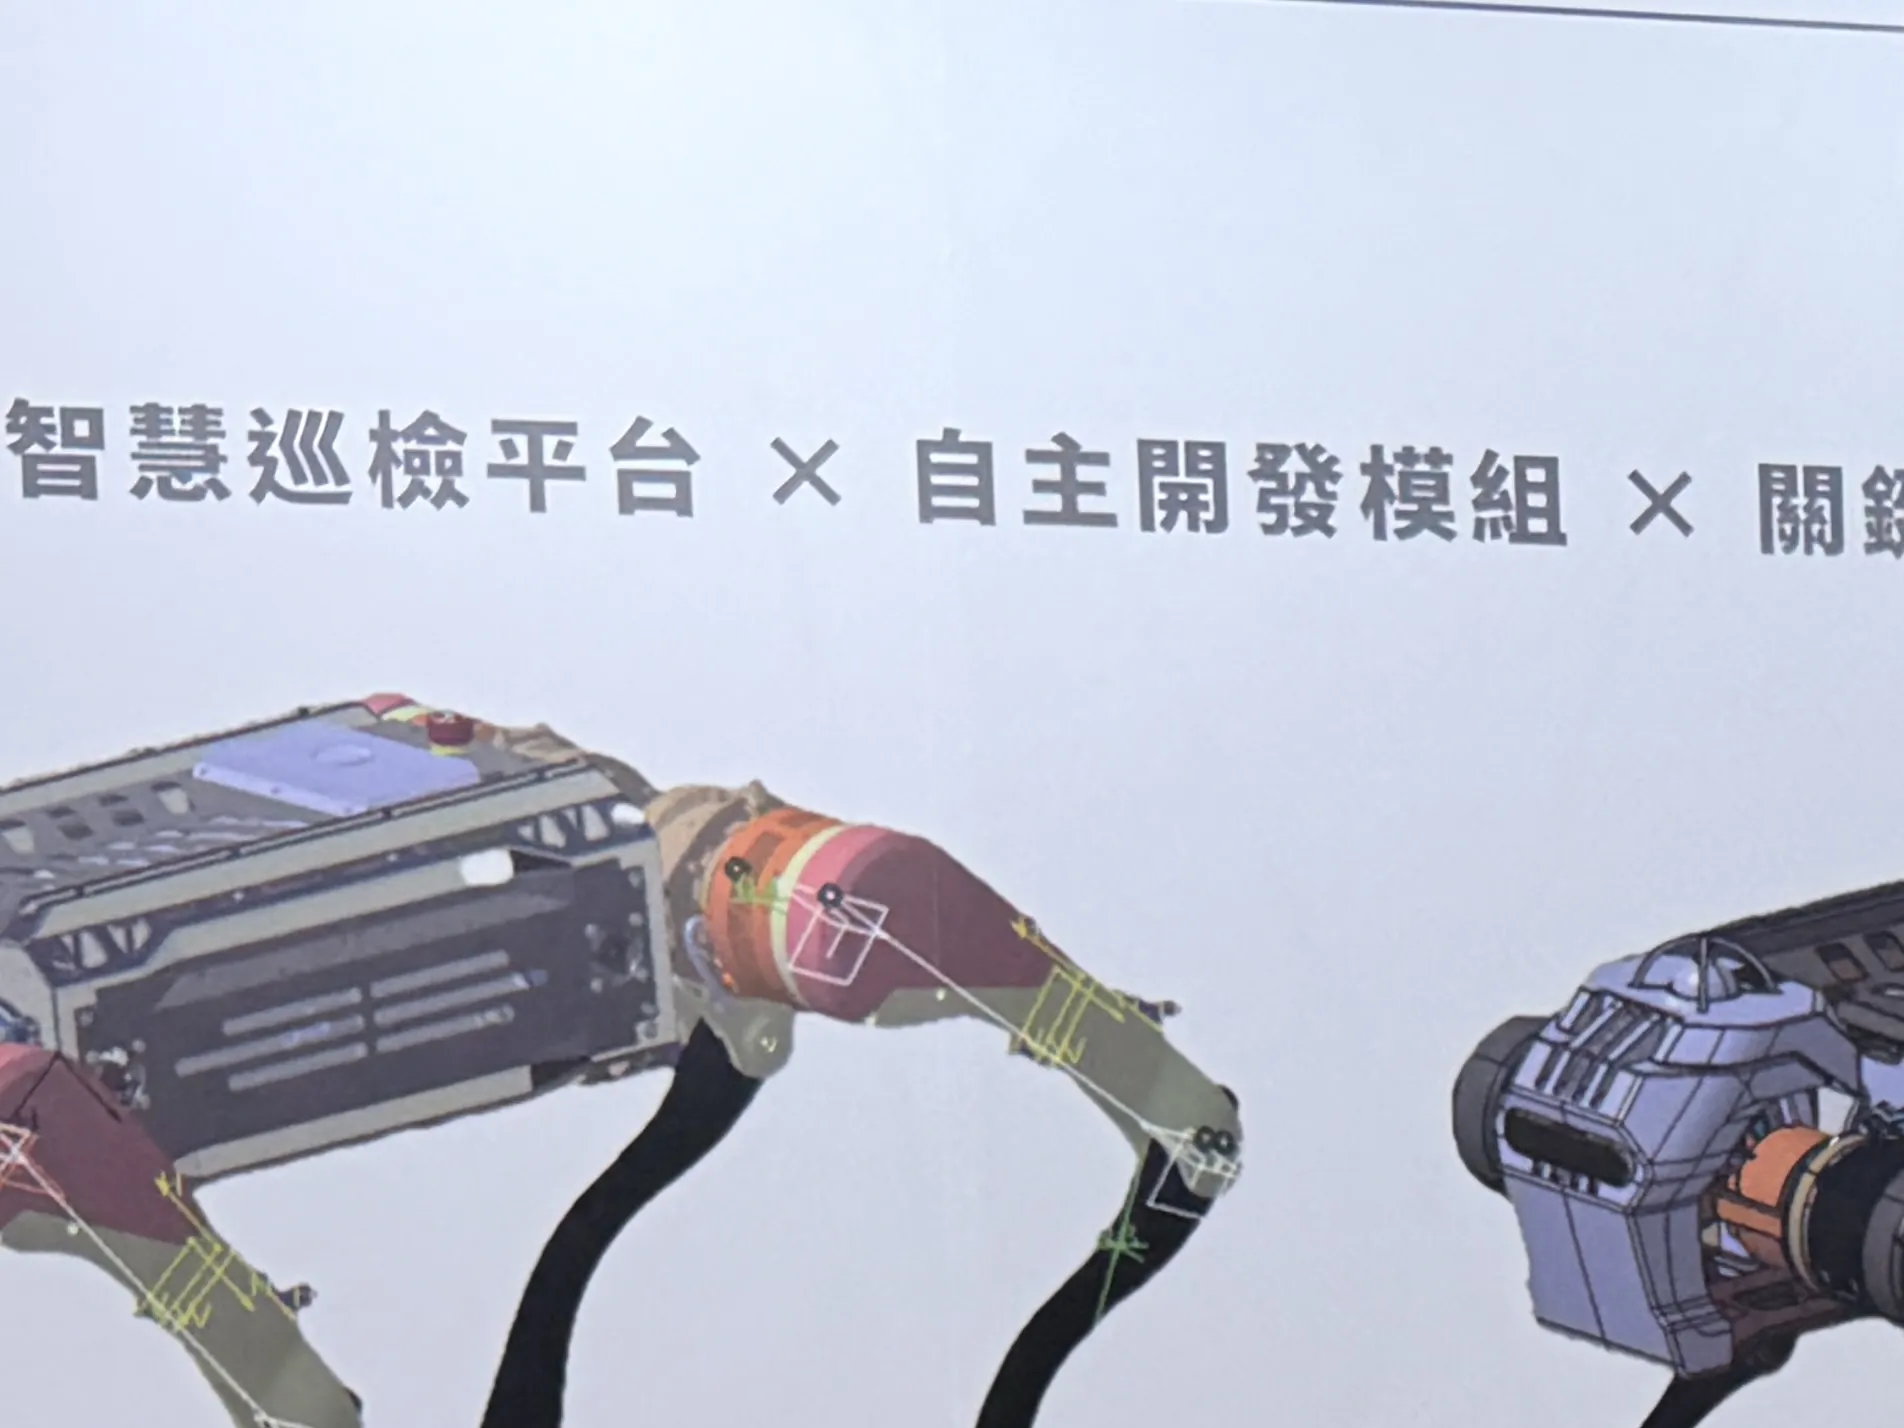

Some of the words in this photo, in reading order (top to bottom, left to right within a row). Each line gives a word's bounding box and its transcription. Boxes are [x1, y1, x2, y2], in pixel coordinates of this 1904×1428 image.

[5, 397, 701, 519] 智慧巡檢平台
[914, 427, 1569, 547] 自主開發模組
